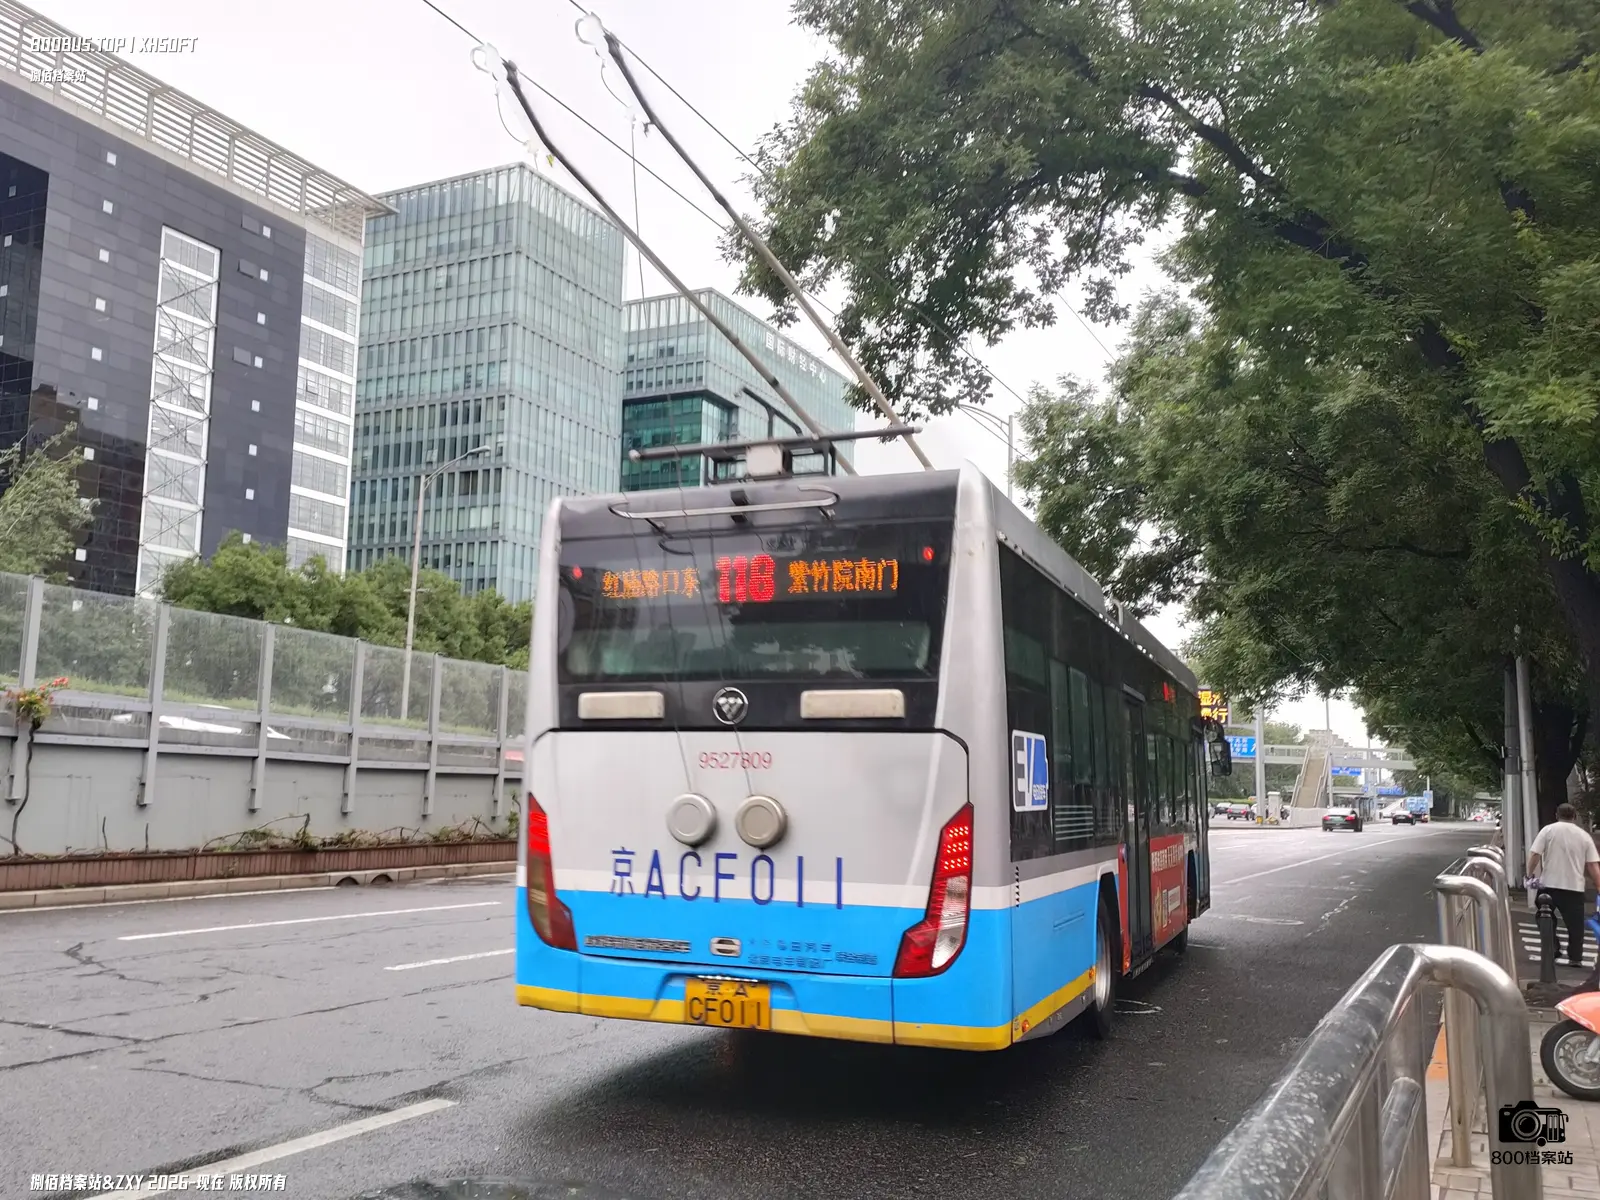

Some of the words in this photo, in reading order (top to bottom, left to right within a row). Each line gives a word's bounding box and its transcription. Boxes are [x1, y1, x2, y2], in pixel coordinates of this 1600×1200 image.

[715, 554, 776, 603] 118
[787, 557, 899, 593] 紫竹院南门
[699, 752, 773, 769] 9527809
[689, 996, 761, 1027] CF011
